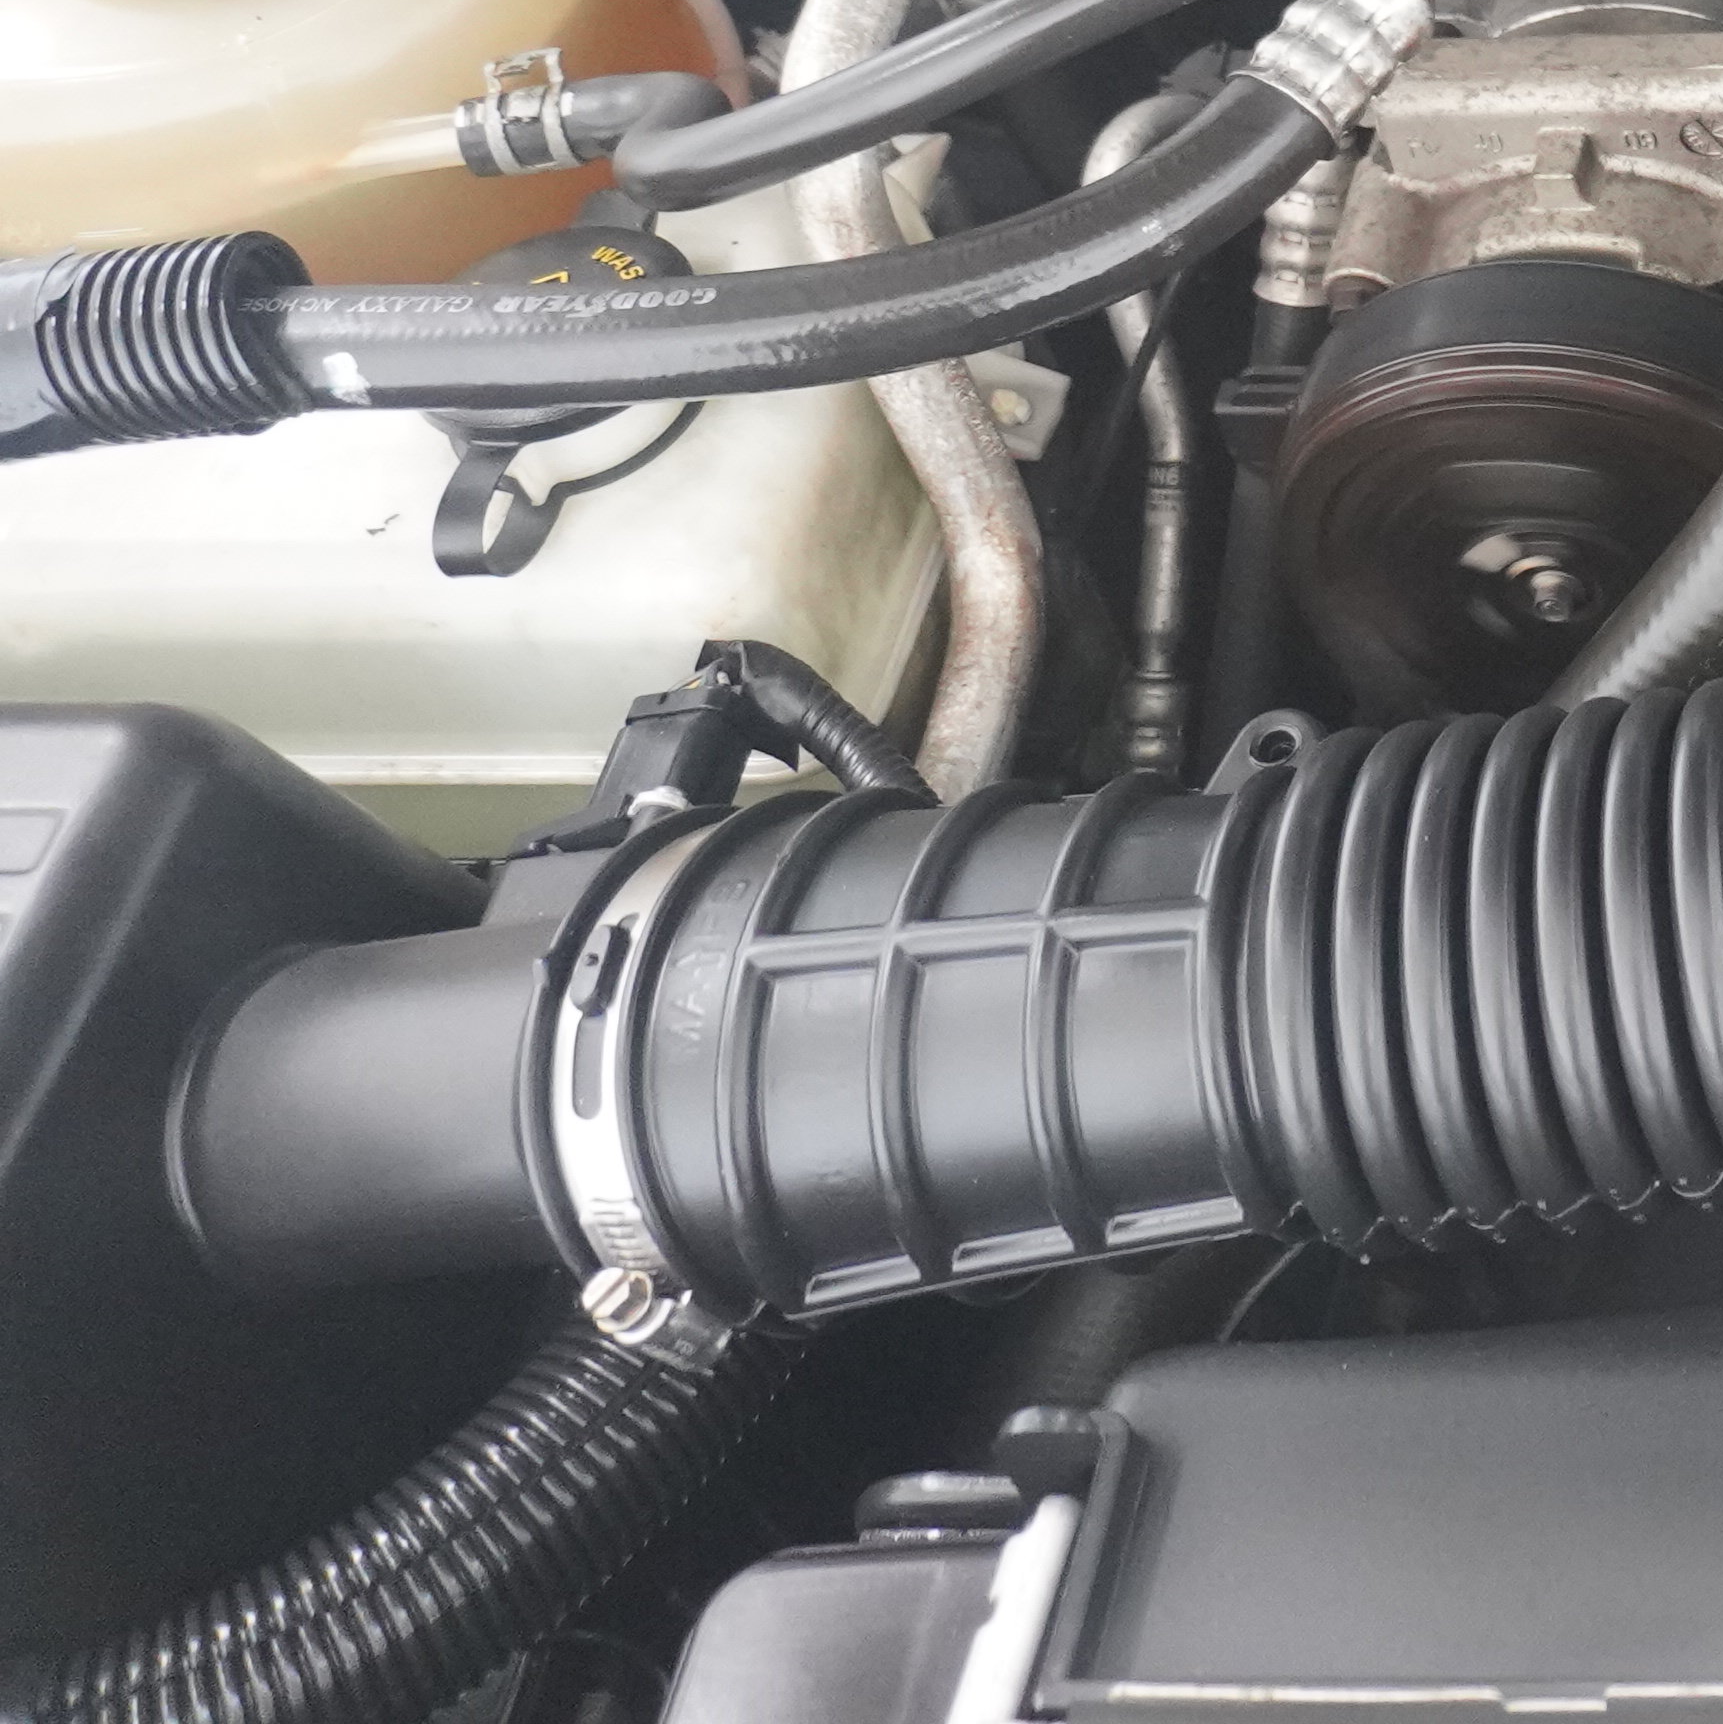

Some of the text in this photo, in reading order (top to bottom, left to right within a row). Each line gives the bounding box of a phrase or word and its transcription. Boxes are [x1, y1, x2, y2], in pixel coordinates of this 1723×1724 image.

[239, 297, 299, 312] HOSE
[346, 295, 474, 313] GALAXY
[493, 287, 717, 317] GOODYEAR
